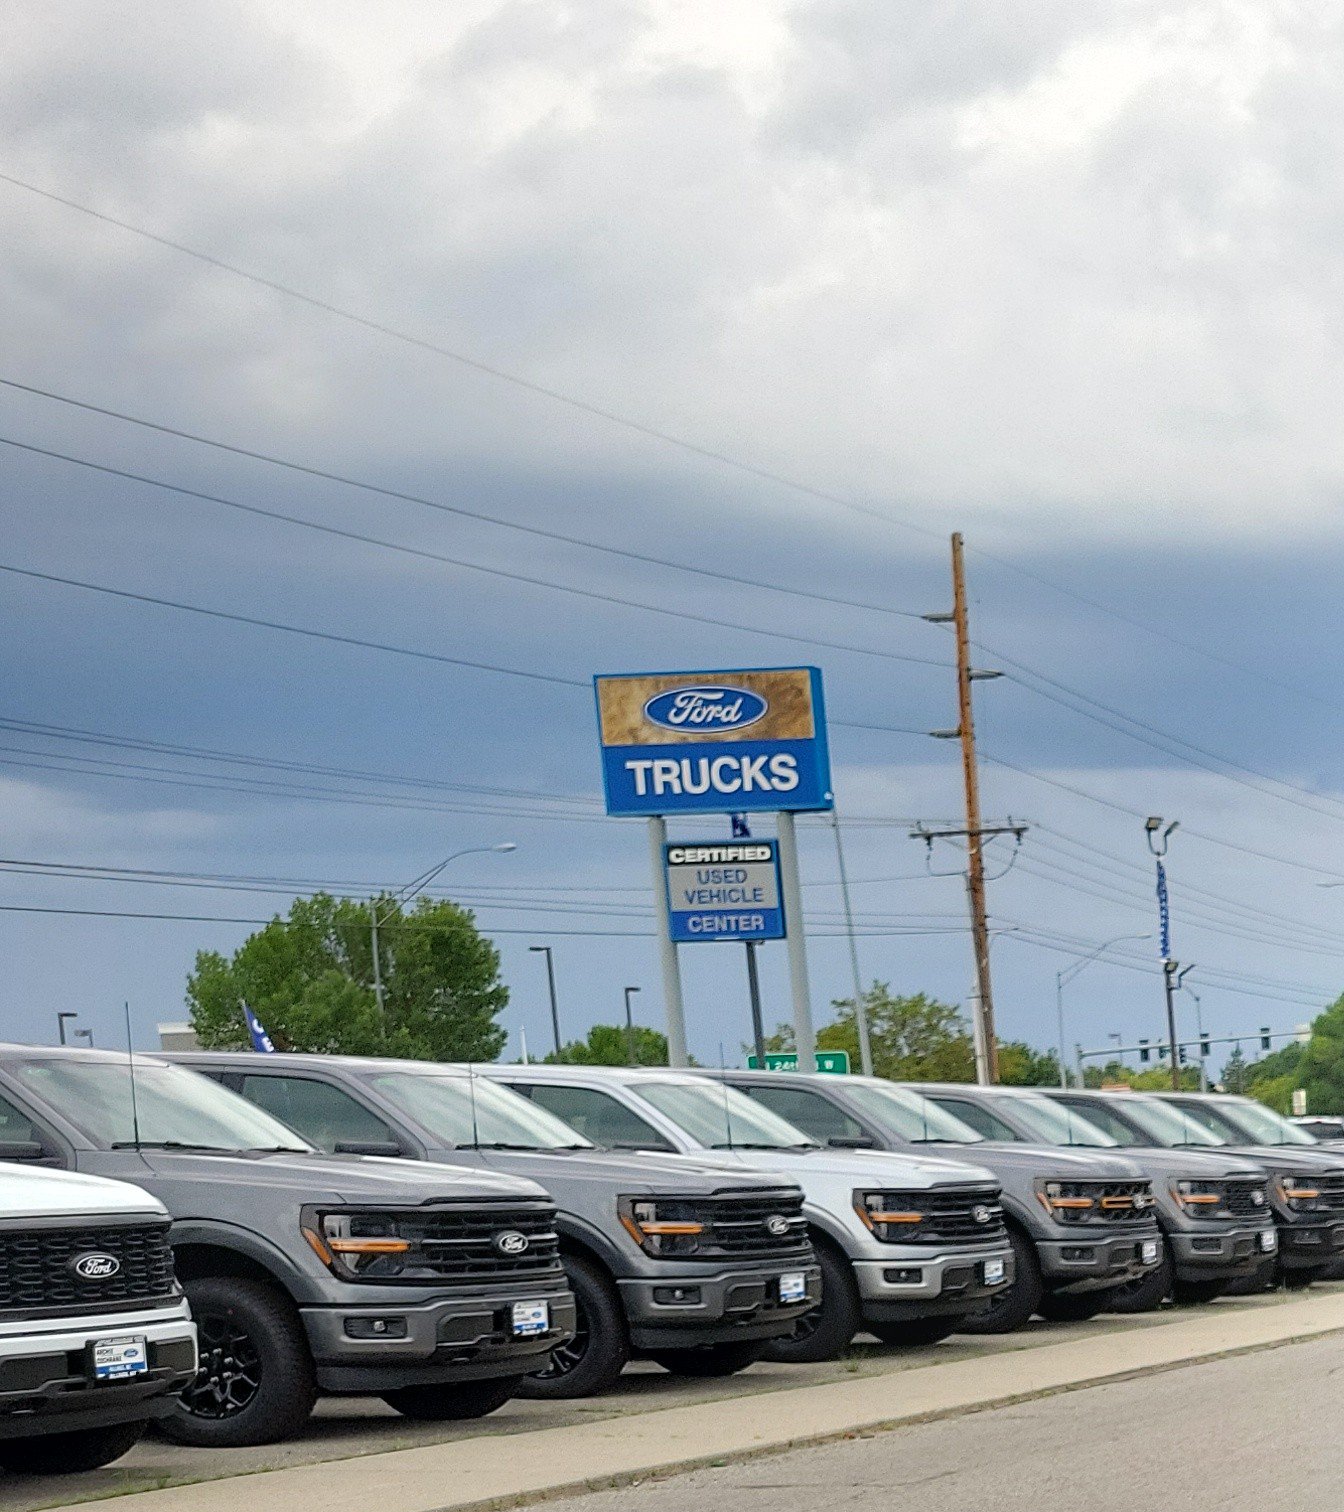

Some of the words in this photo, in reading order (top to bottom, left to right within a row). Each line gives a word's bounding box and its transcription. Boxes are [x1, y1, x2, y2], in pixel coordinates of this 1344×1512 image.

[668, 691, 743, 724] Ford
[625, 754, 799, 795] TRUCKS
[669, 845, 772, 863] CERTIFIED
[697, 868, 748, 885] USED
[684, 887, 764, 905] VEHICLE
[688, 914, 765, 933] CENTER
[84, 1258, 112, 1275] Ford
